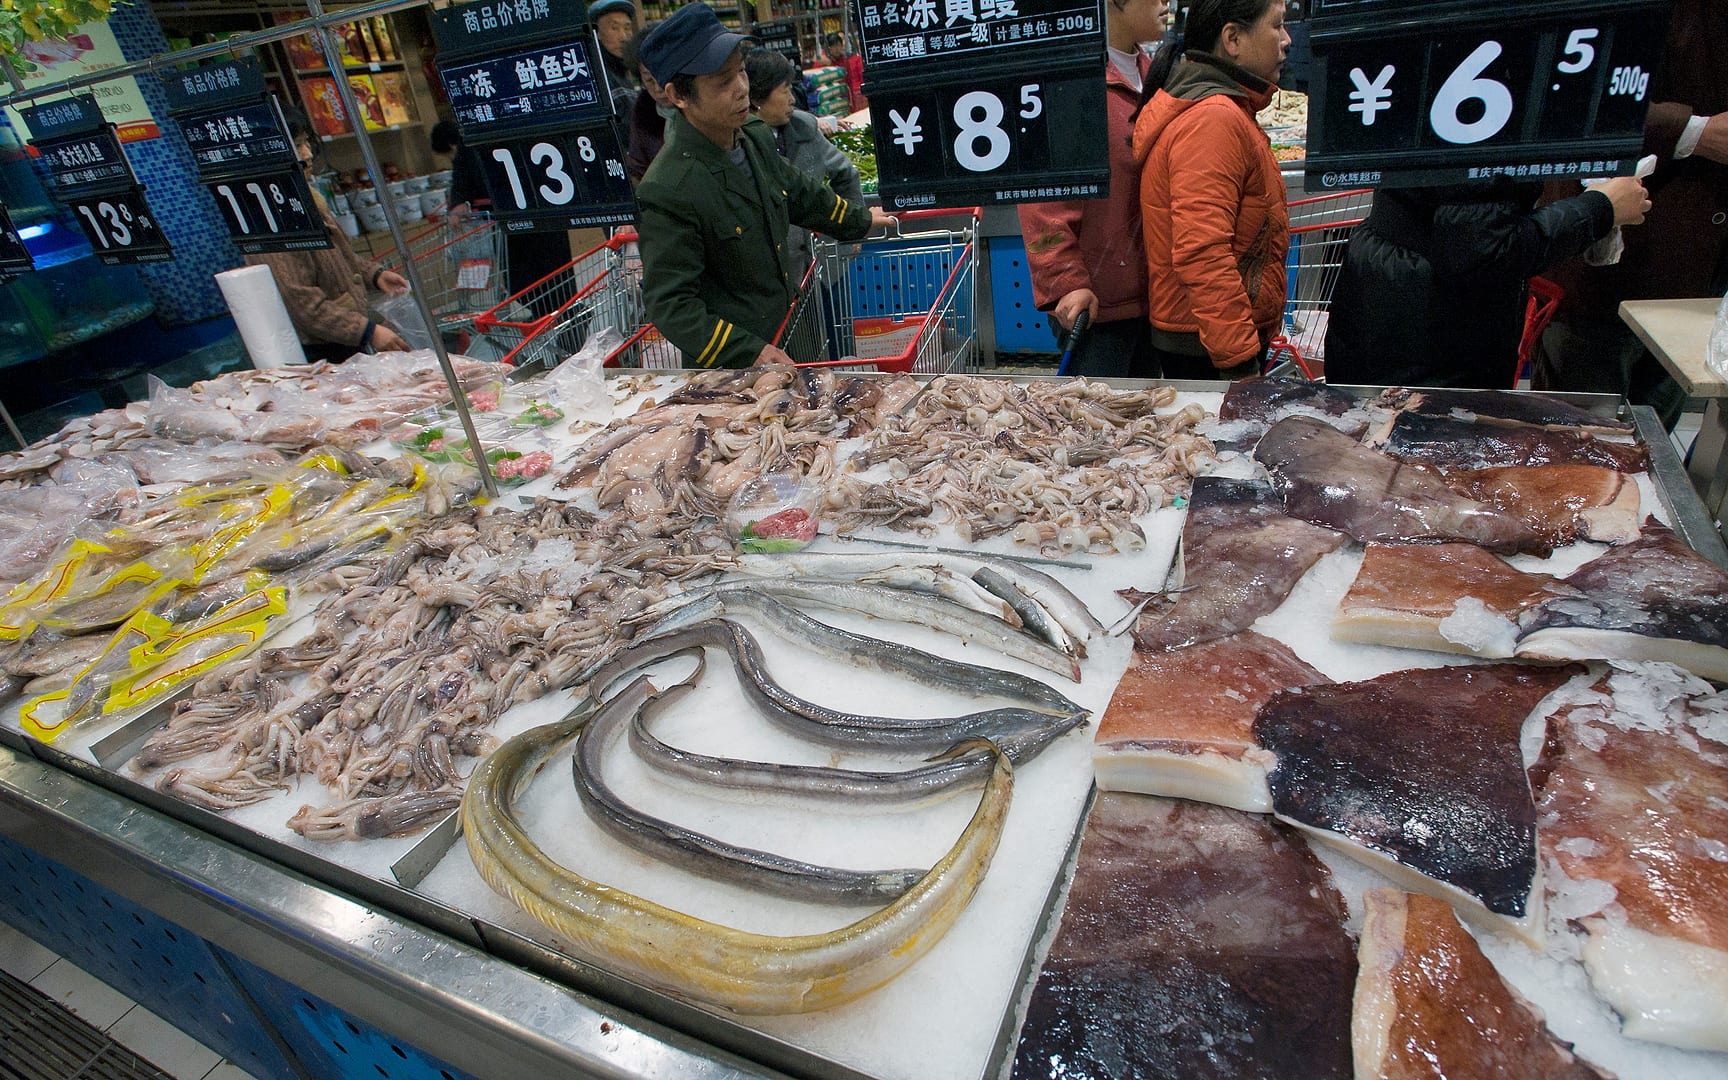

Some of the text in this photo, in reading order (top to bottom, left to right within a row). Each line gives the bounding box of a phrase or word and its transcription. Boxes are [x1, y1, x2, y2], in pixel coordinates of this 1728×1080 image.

[463, 0, 550, 34] 商品价格牌
[1057, 15, 1094, 32] 500g
[182, 66, 241, 95] 商品价格牌
[515, 49, 588, 91] 鱿鱼头
[1609, 65, 1650, 101] 500g
[605, 159, 626, 180] 500g
